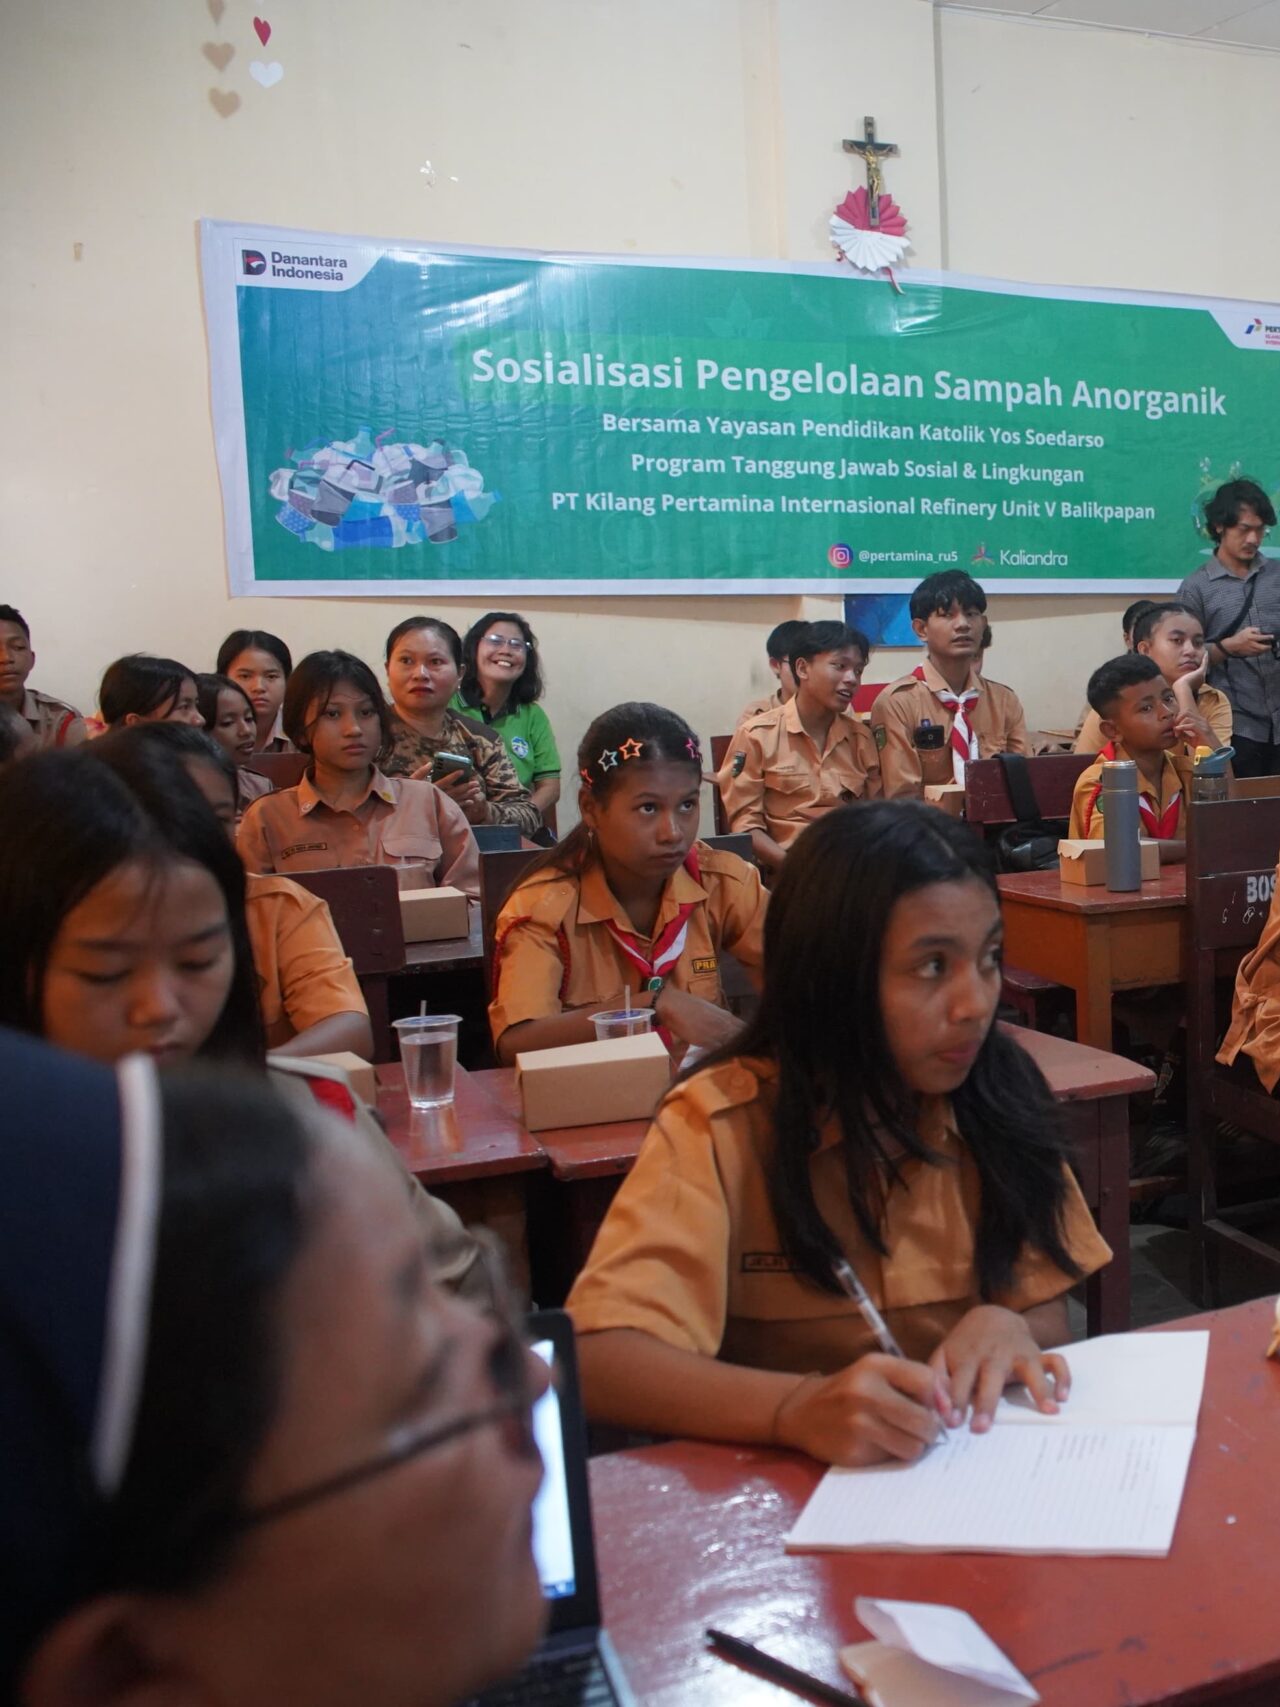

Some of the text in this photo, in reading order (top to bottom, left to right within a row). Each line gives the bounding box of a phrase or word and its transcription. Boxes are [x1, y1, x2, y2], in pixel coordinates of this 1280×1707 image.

[271, 251, 347, 268] Danantara
[272, 265, 343, 281] Indonesia
[471, 348, 1227, 420] Sosialisasi Pengelolaan Sampah Anorganik
[602, 413, 1105, 448] Bersama Yayasan Pendidikan Katolik Yos Soedarso
[631, 453, 1084, 487] Program Tanggung Jawab Sosial & Lingkungan
[551, 491, 1156, 524] PT Kilang Pertamina Internasional Refinery Unit V Balikpapan
[858, 549, 1069, 567] @pertamina_ru5 Kaliandra
